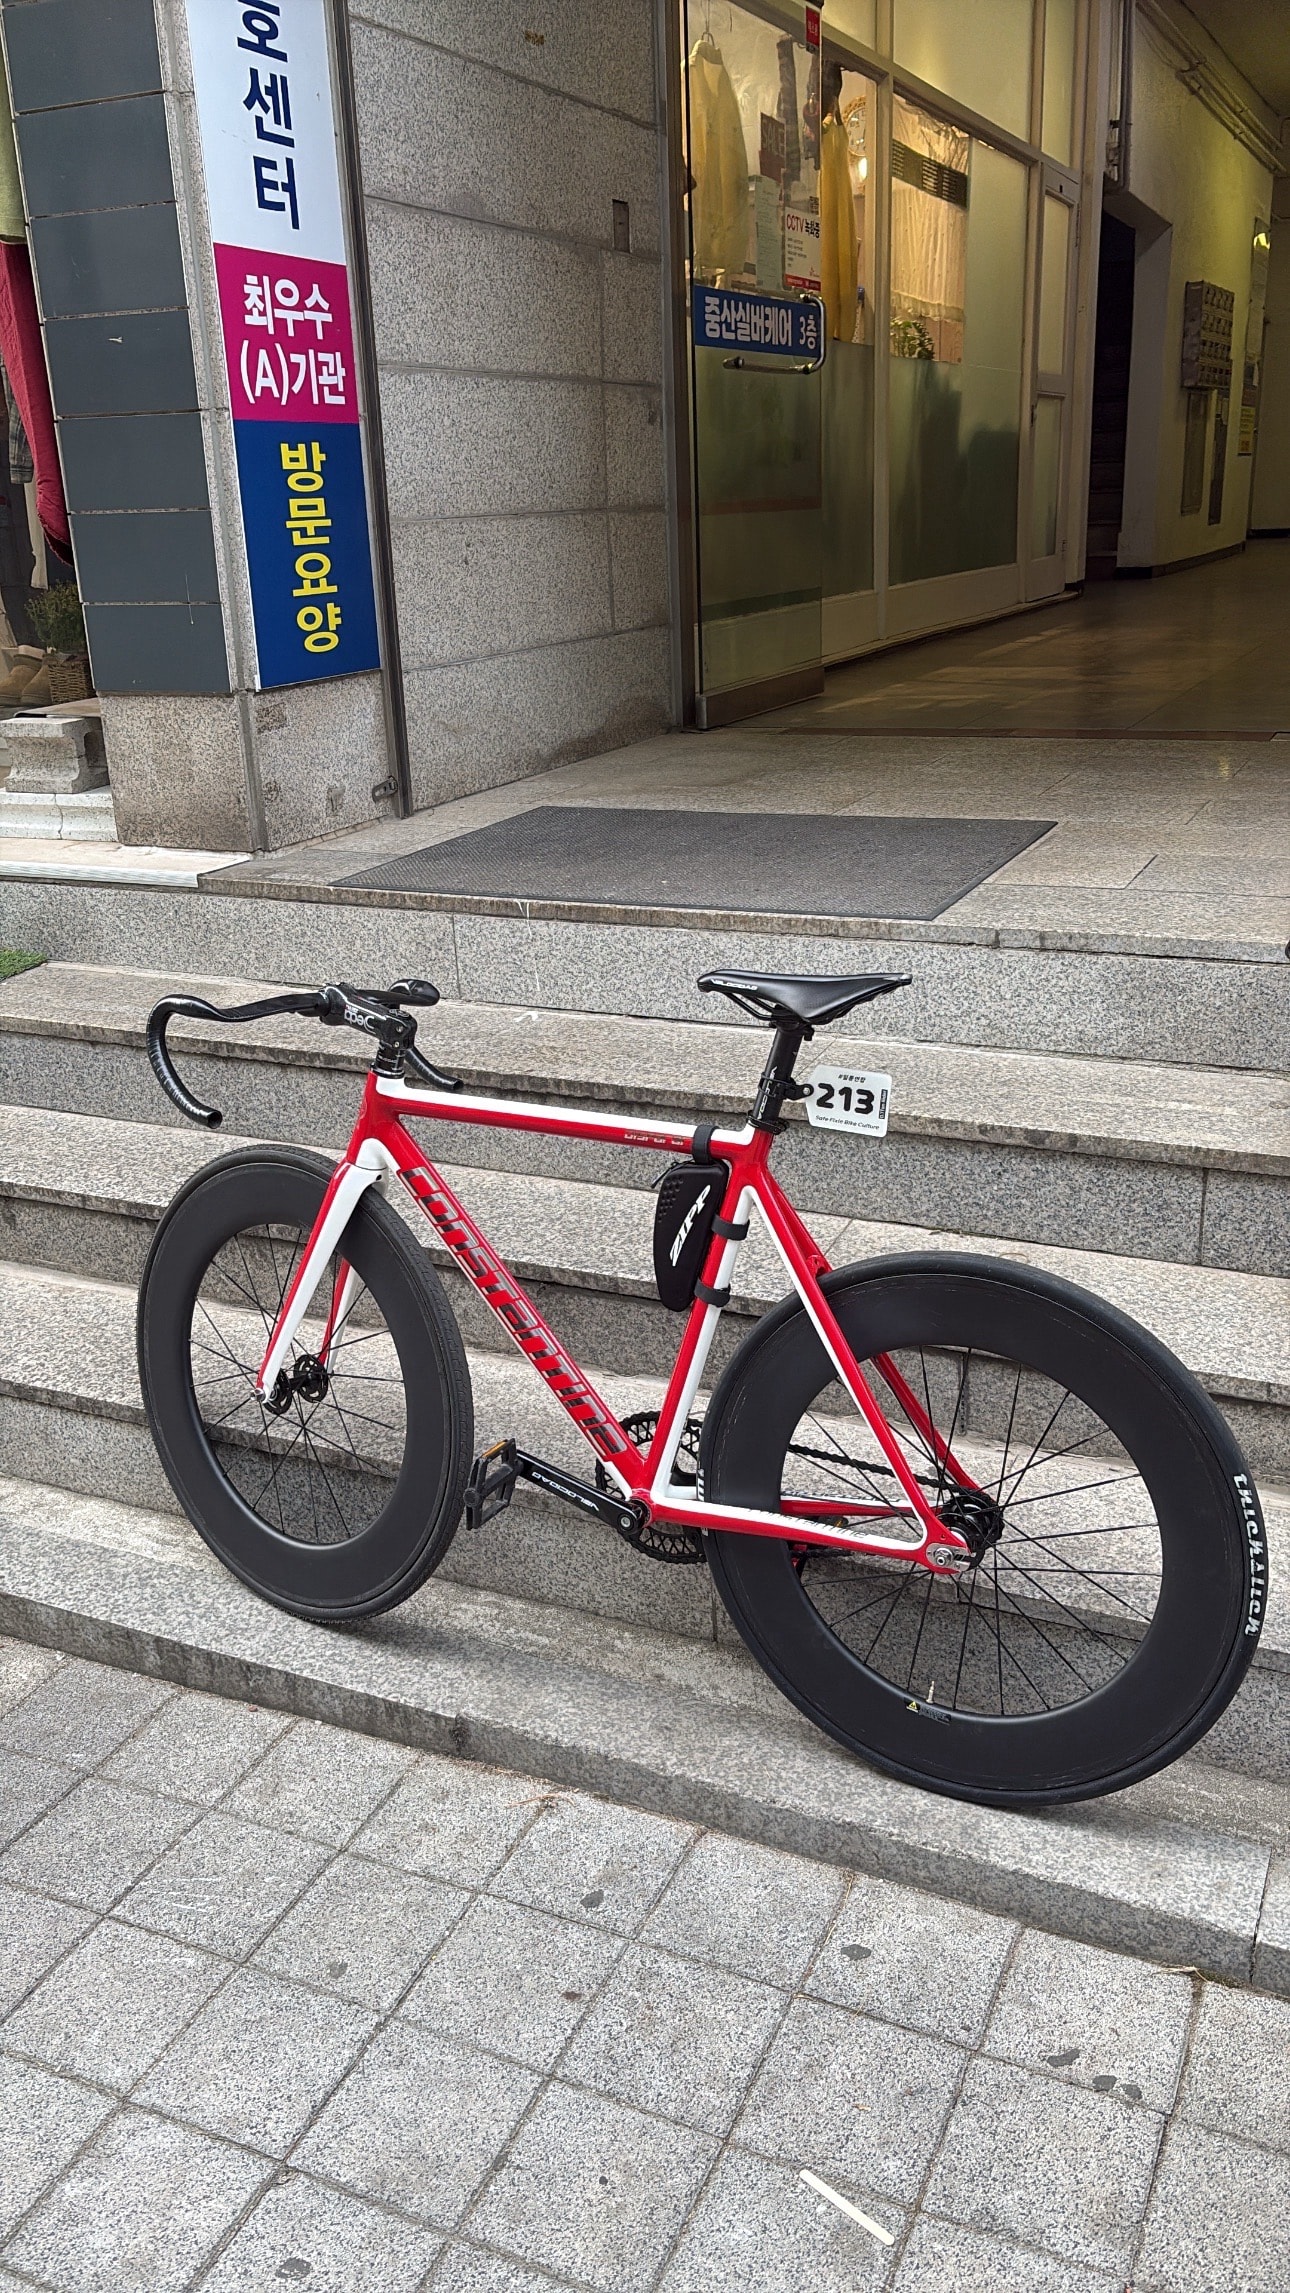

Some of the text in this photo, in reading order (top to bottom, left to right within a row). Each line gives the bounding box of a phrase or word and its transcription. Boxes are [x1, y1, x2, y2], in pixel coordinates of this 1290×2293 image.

[787, 213, 805, 232] CCTV
[243, 274, 333, 340] 최우수
[705, 296, 817, 350] 중산실버케어 3층
[240, 339, 346, 406] (A)기관
[280, 441, 342, 653] 방문요양
[816, 1082, 875, 1115] 213
[829, 1116, 844, 1125] Fixie
[844, 1119, 857, 1127] Bike
[857, 1121, 880, 1130] Culture
[669, 1184, 711, 1267] ZIPP
[531, 1471, 600, 1512] VELOCIDAD
